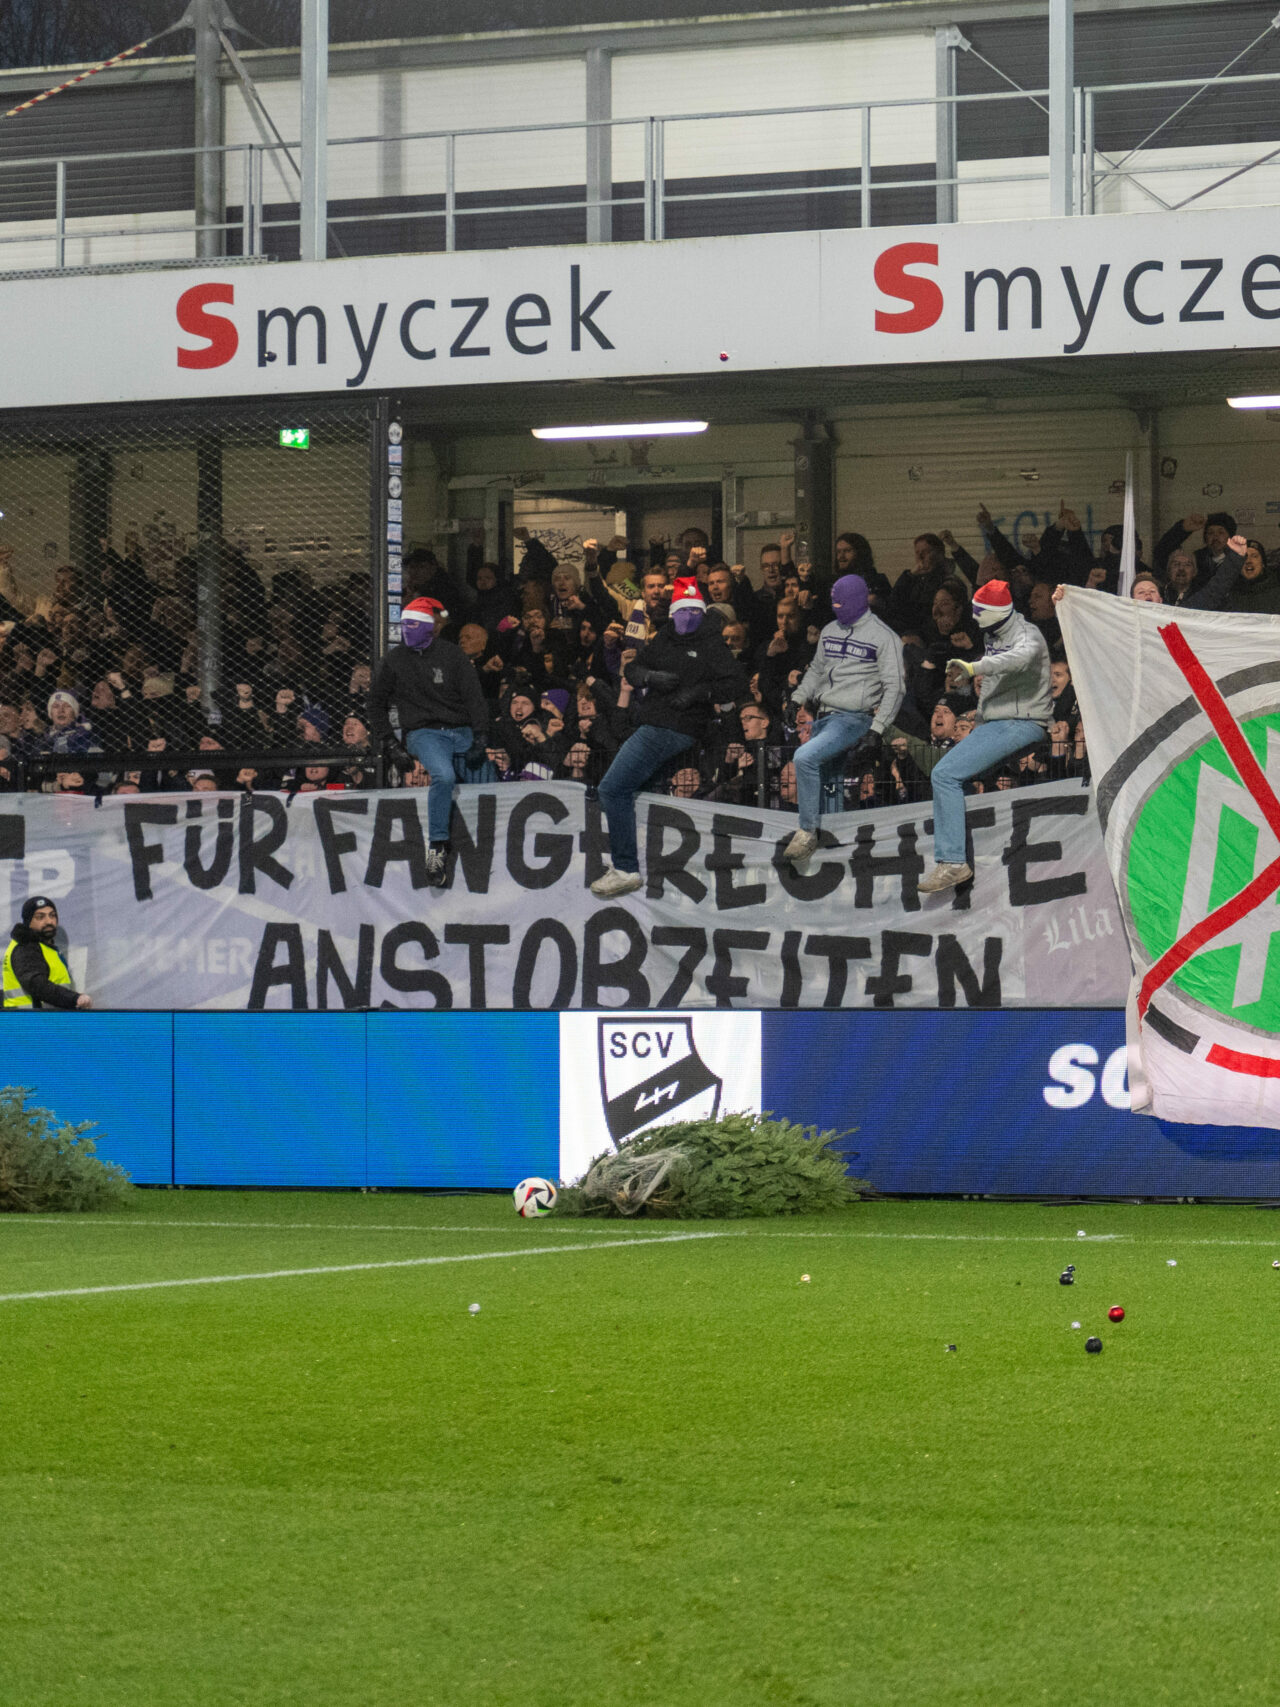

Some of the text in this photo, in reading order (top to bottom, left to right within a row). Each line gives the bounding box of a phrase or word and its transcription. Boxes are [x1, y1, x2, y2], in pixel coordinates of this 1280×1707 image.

[176, 264, 615, 388] Smyczek
[124, 793, 294, 901] FÜR
[1042, 904, 1114, 954] Lila
[610, 1031, 673, 1058] SCV
